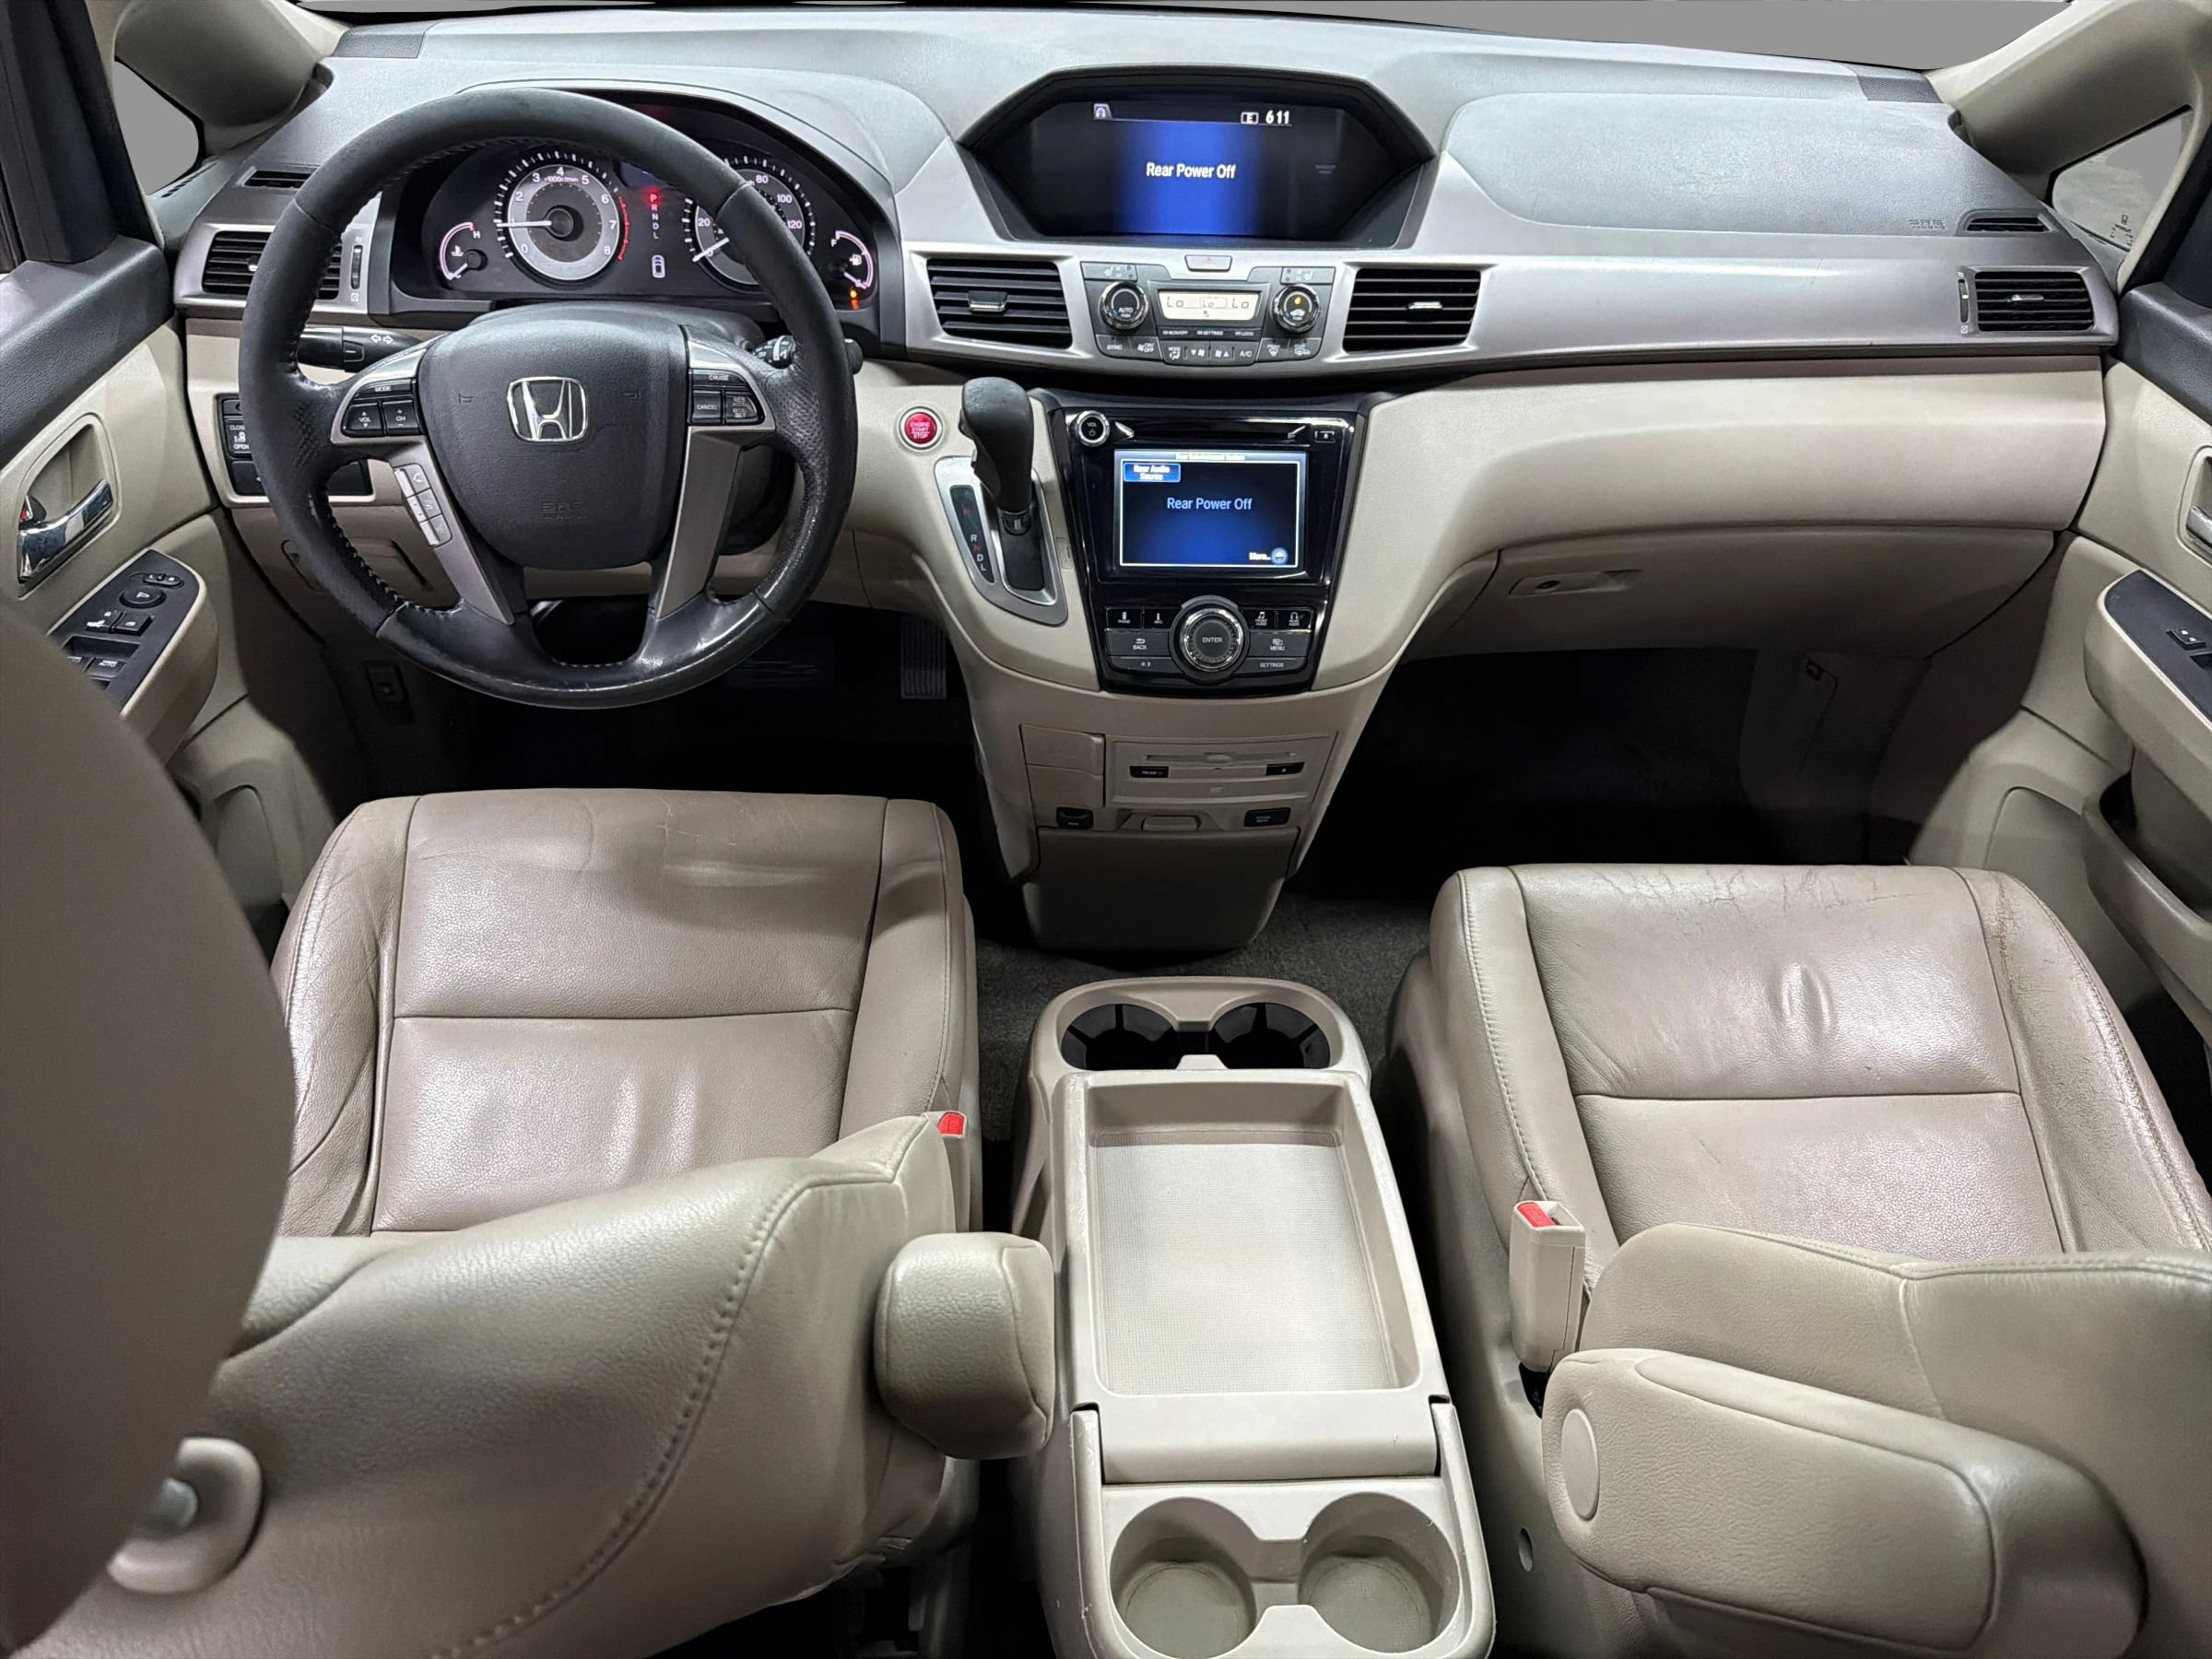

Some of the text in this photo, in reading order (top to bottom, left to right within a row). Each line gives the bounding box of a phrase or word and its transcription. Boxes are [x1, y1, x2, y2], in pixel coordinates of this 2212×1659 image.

[1265, 110, 1290, 124] 611
[556, 166, 564, 176] 4
[1146, 162, 1237, 179] Rear Power Off
[532, 172, 540, 182] 3
[582, 175, 590, 185] 5
[756, 175, 769, 183] 80
[515, 191, 524, 201] 2
[601, 194, 609, 204] 6
[650, 194, 658, 203] P
[777, 194, 793, 203] 100
[608, 220, 618, 230] 7
[653, 222, 660, 230] D
[698, 218, 711, 227] 20
[787, 219, 803, 229] 120
[473, 230, 481, 239] H
[653, 231, 660, 240] L
[830, 239, 837, 247] F
[521, 243, 528, 253] 0
[604, 245, 611, 254] 8
[1167, 497, 1253, 511] Rear Power Off
[970, 534, 978, 543] R
[973, 544, 982, 553] N
[977, 553, 984, 562] D
[980, 563, 987, 571] L
